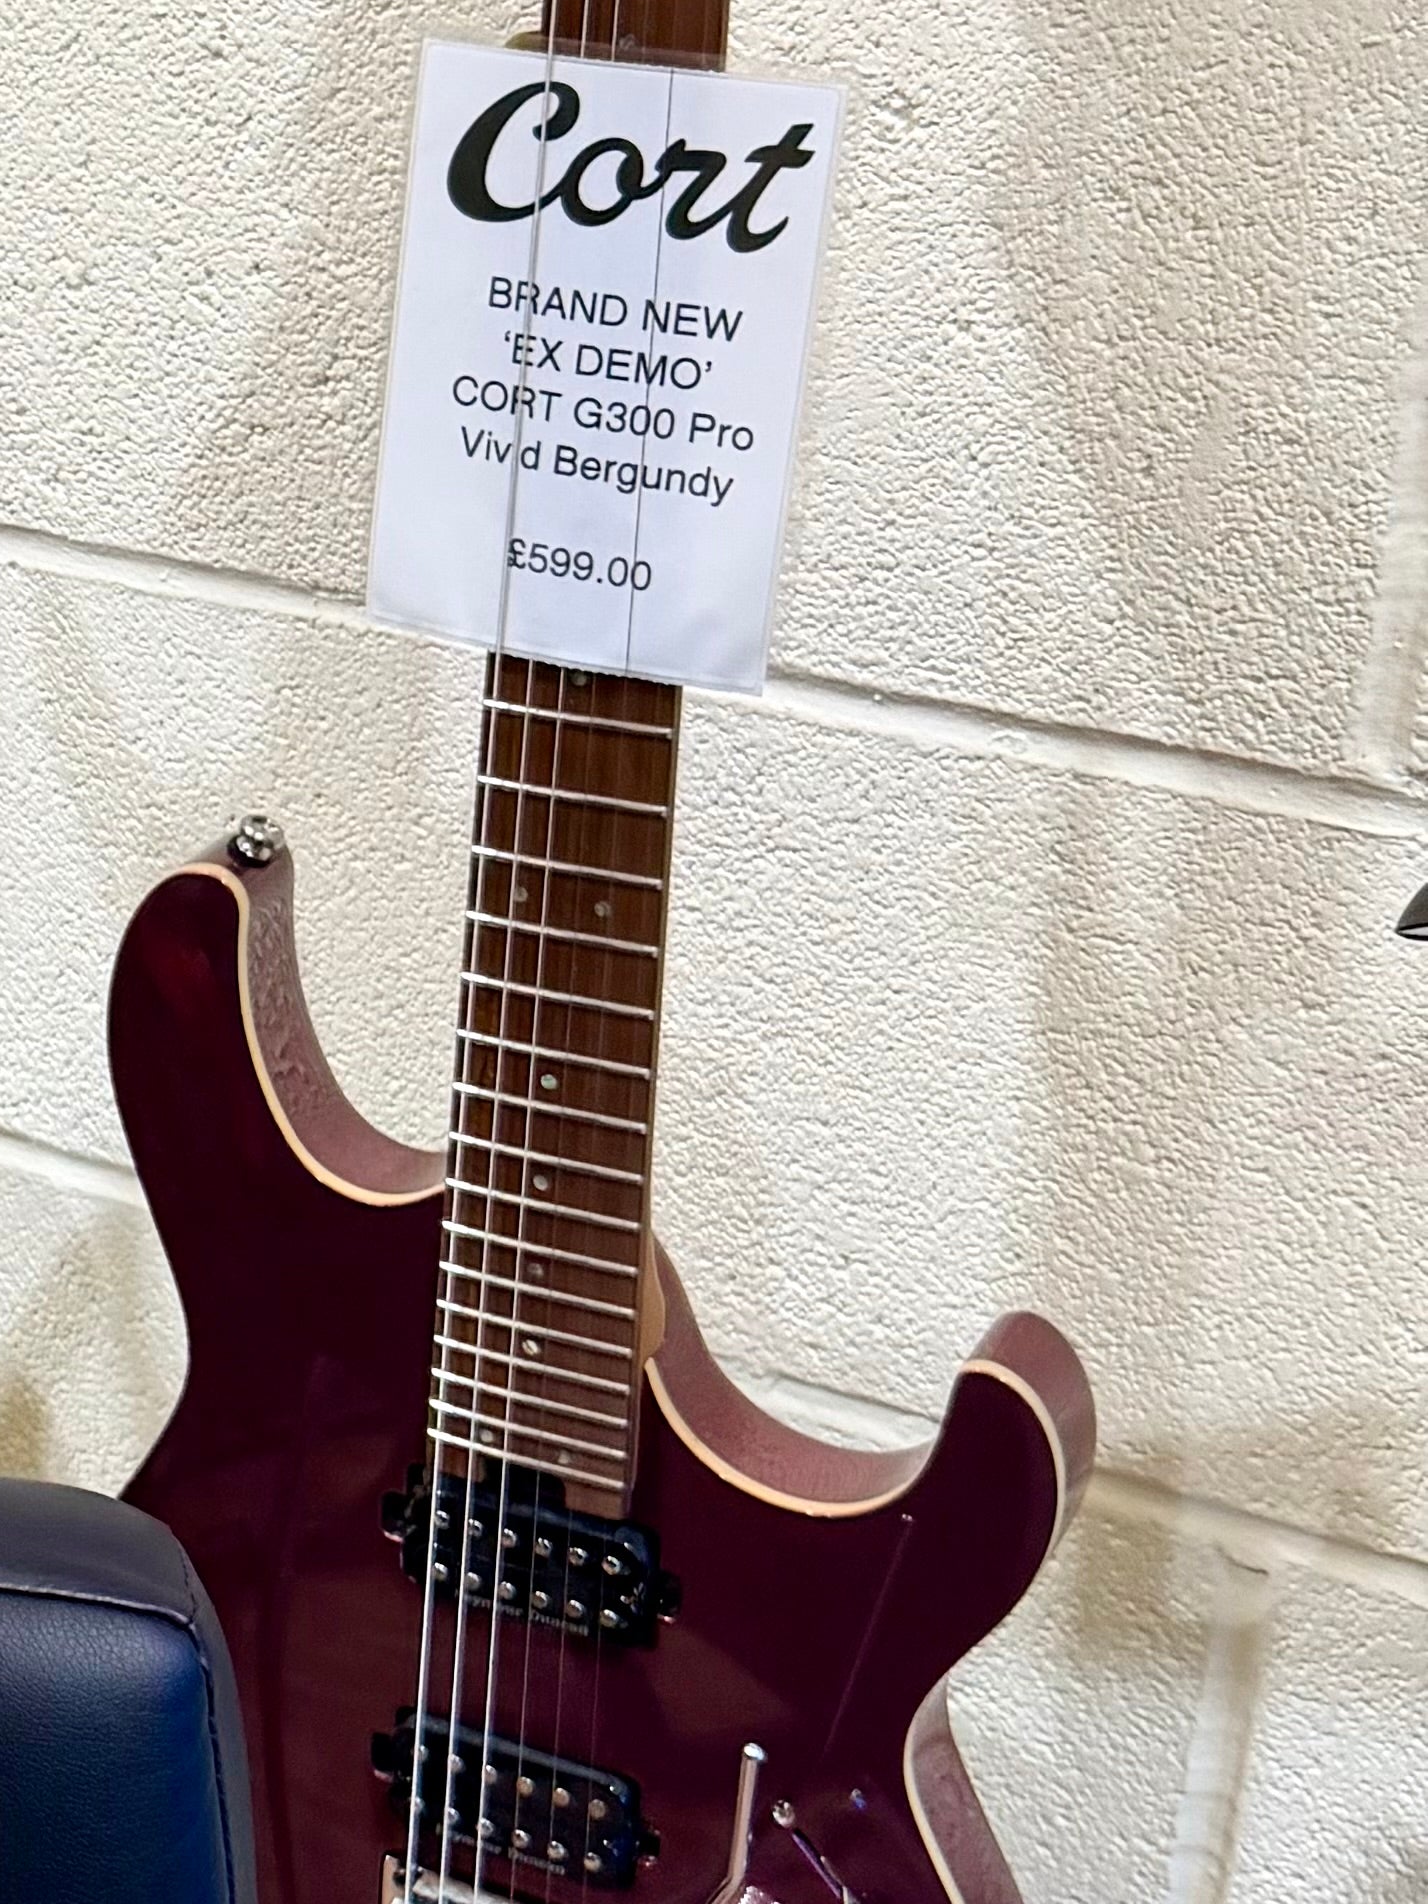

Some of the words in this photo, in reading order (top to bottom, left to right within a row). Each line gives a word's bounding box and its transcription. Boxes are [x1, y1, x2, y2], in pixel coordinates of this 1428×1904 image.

[446, 80, 816, 253] Cort
[488, 276, 628, 327] BRAND
[641, 299, 743, 342] NEW
[452, 375, 563, 423] CORT
[573, 396, 676, 440] G300
[688, 412, 755, 451] Pro
[553, 444, 735, 507] Bergundy
[505, 538, 653, 591] £599.00
